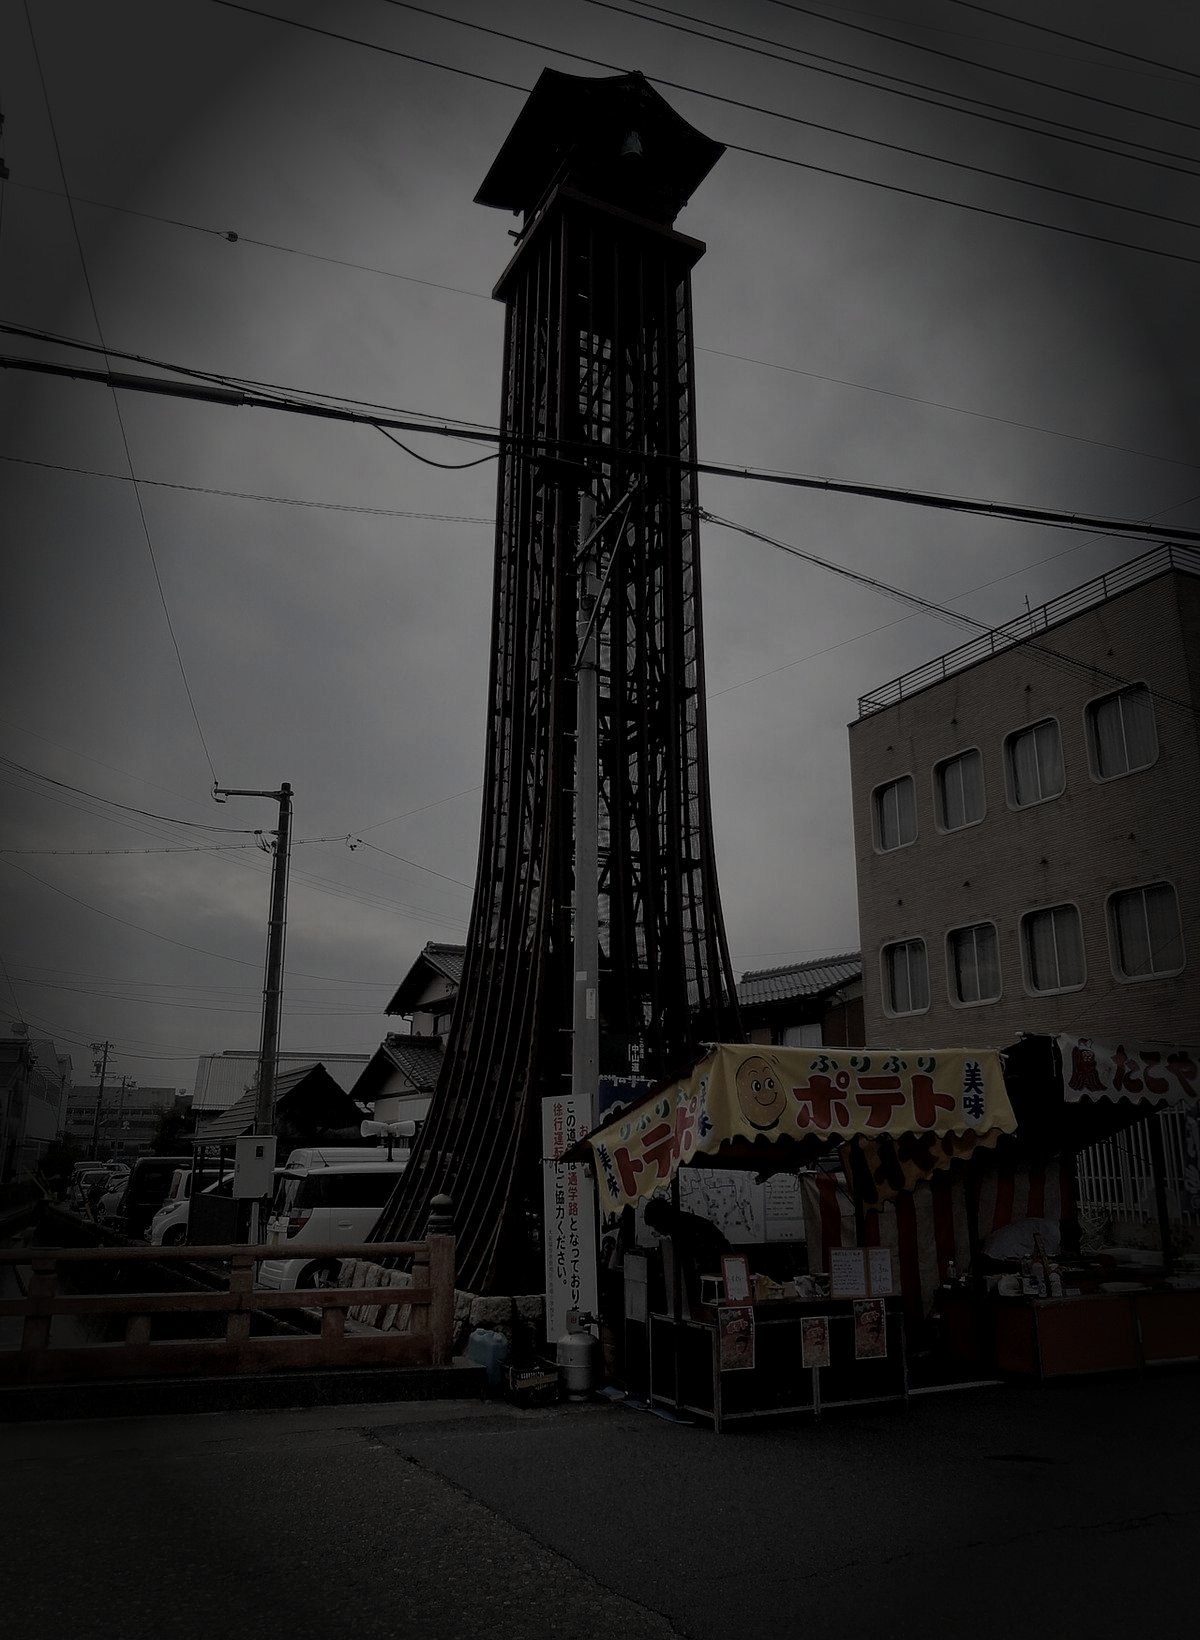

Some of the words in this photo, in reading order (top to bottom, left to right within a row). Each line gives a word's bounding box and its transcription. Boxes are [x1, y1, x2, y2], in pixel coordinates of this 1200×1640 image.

[792, 1070, 956, 1130] ポテト
[963, 1060, 985, 1119] 美味
